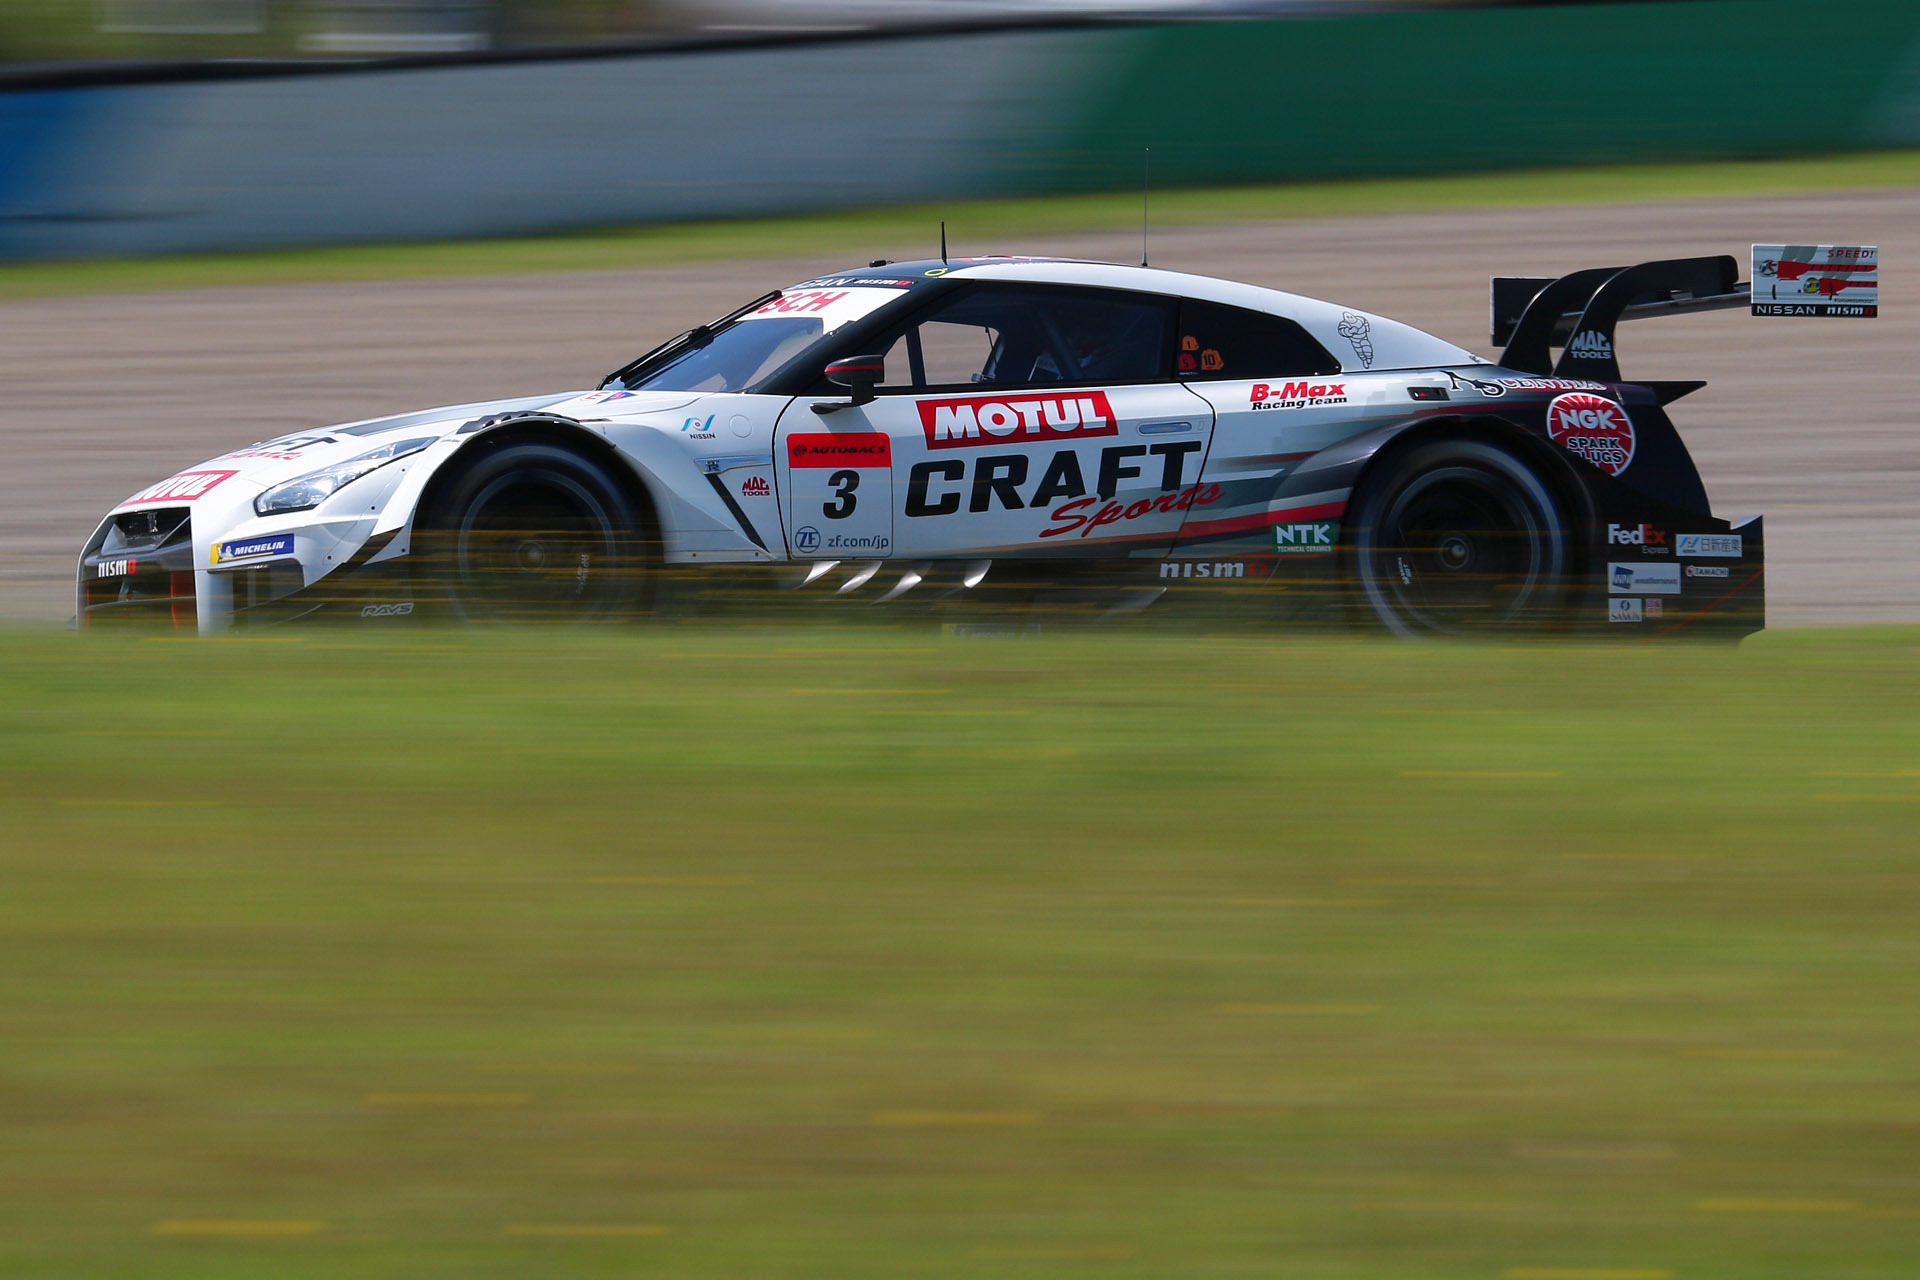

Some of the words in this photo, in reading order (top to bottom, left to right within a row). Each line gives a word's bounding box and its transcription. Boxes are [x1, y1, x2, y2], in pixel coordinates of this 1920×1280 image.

[1826, 249, 1875, 259] SPEED!
[754, 292, 851, 314] SCH
[1756, 306, 1817, 315] NISSAN
[1826, 306, 1875, 316] nismo
[1571, 330, 1612, 351] MAC
[1203, 354, 1217, 366] 10
[1571, 351, 1612, 359] TOOLS
[1249, 381, 1347, 402] B-Max
[1251, 400, 1307, 411] Racing
[1308, 397, 1348, 406] Team
[935, 398, 1108, 441] MOTUL
[1558, 409, 1618, 430] NGK
[809, 446, 887, 455] AUTOBACS
[1567, 437, 1621, 449] SPARK
[741, 476, 771, 491] MAC
[904, 440, 1202, 518] CRAFT
[823, 469, 860, 520] 3
[1038, 482, 1227, 538] Sports
[798, 531, 820, 549] ZF
[828, 535, 889, 550] zf.com/jp
[1276, 523, 1332, 545] NTK
[1608, 523, 1666, 545] FedEx
[234, 541, 286, 556] MICHELIN
[1160, 562, 1269, 578] nismo
